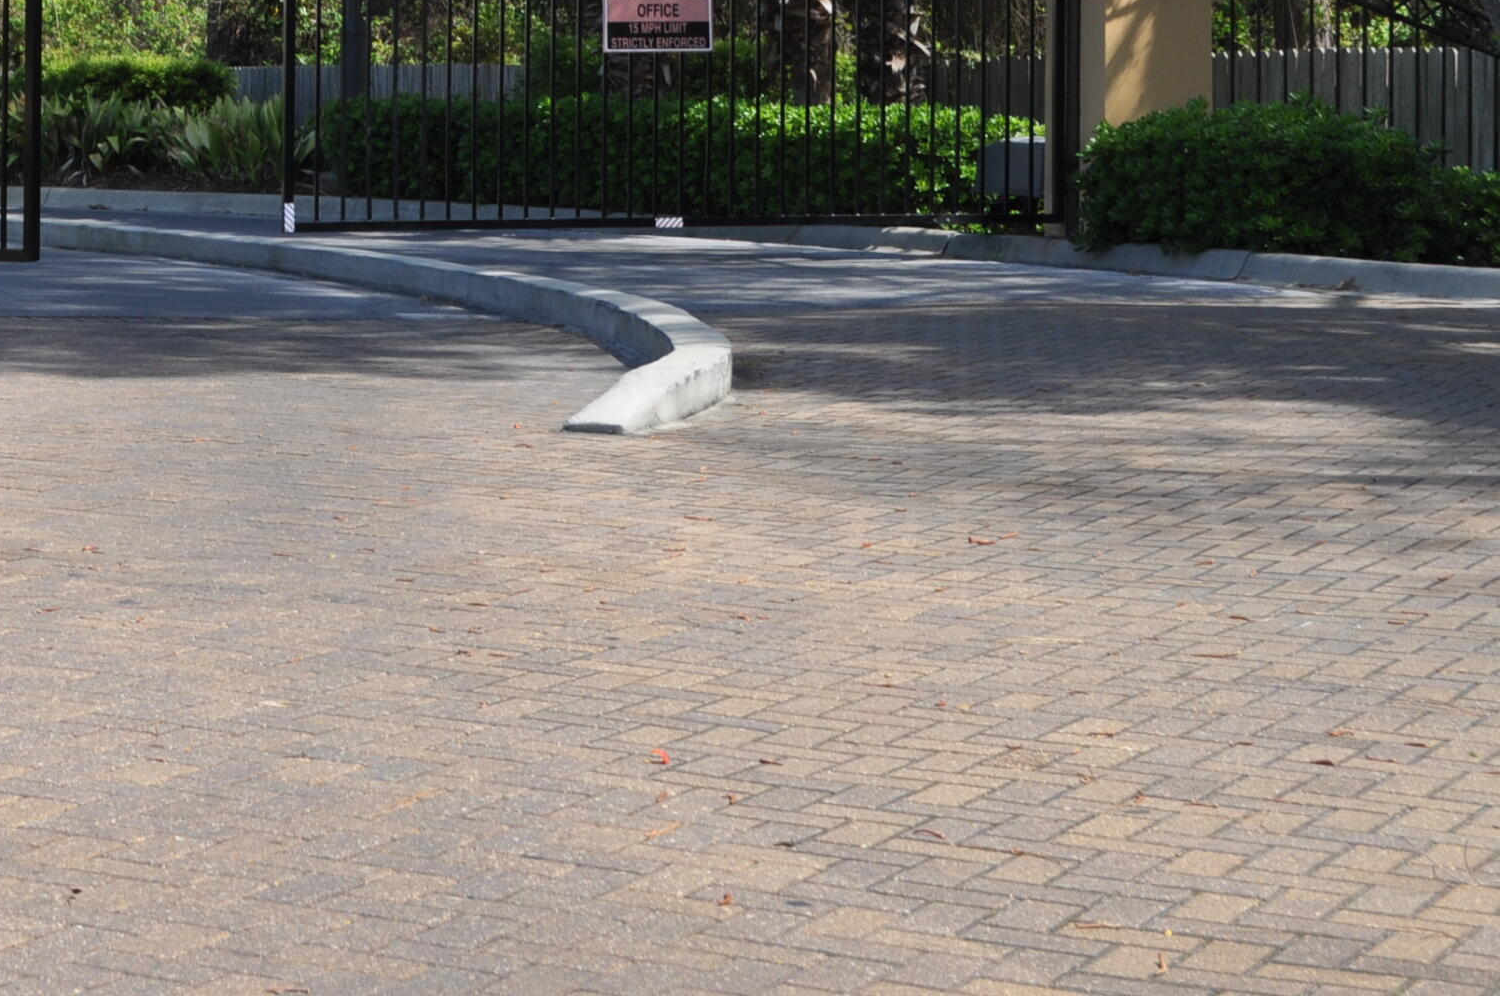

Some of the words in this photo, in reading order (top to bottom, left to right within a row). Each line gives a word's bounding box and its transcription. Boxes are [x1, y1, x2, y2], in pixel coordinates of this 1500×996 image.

[637, 3, 680, 17] OFFICE
[628, 23, 639, 34] 15
[641, 23, 661, 34] MPH
[663, 23, 688, 34] LIMIT
[611, 37, 654, 48] STRICTLY
[656, 37, 706, 48] ENFORCED
